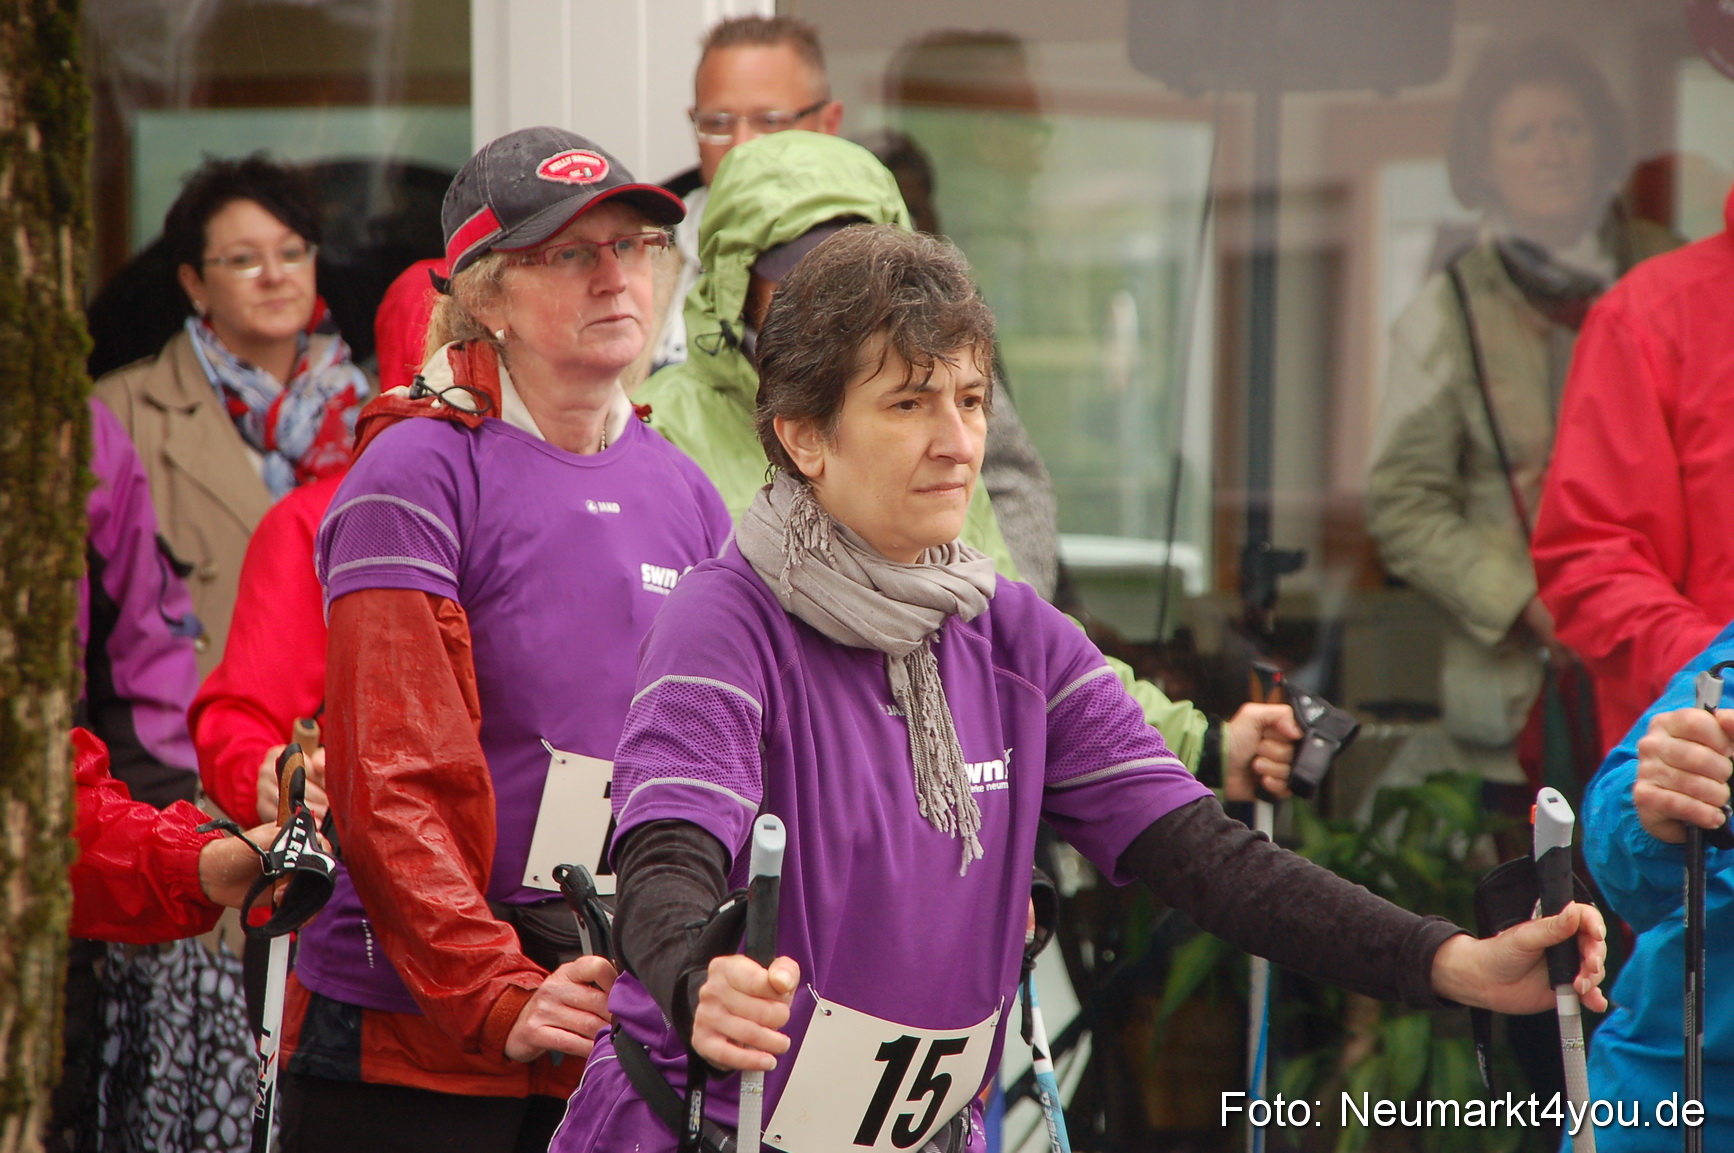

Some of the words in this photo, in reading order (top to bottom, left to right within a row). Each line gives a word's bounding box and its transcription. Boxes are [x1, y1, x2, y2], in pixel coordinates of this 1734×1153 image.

[641, 562, 679, 590] swn
[886, 704, 905, 716] JA
[964, 759, 1004, 784] wn
[985, 781, 1009, 791] neum
[283, 826, 306, 868] LEKI
[853, 1034, 970, 1149] 15
